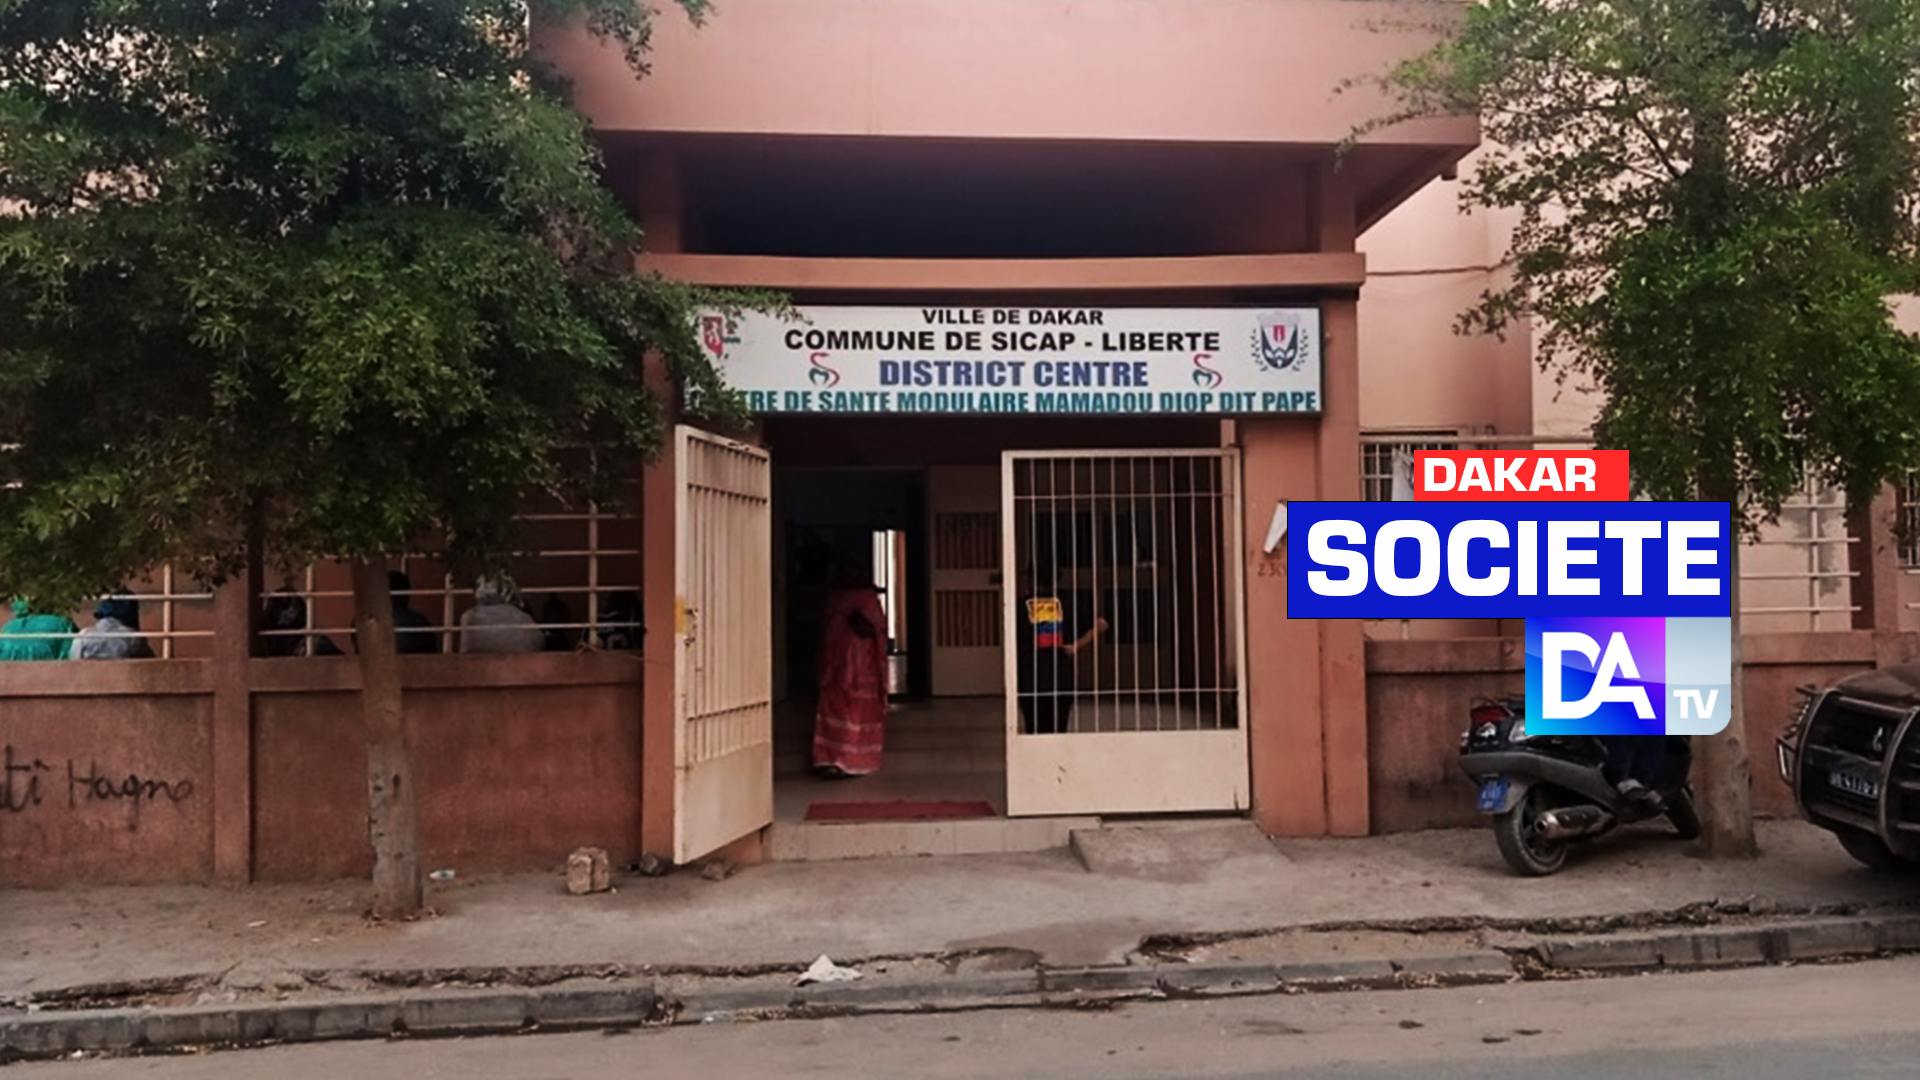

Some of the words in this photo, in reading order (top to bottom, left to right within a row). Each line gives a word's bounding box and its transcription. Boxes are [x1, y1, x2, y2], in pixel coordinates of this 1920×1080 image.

[921, 308, 985, 325] VILLE
[992, 309, 1021, 325] DE
[1028, 309, 1104, 326] DAKAR
[784, 329, 935, 351] COMMUNE
[945, 331, 982, 351] DE
[991, 331, 1076, 352] SICAP
[1102, 331, 1220, 352] LIBERTE
[879, 359, 1026, 387] DISTRICT
[1033, 360, 1149, 388] CENTRE
[784, 390, 811, 412] DE
[818, 390, 890, 413] SANTE
[899, 391, 1029, 413] MODULAIRE
[1034, 391, 1153, 413] MAMADOU
[1159, 392, 1214, 413] DIOP
[1220, 391, 1257, 413] DIT
[1262, 391, 1316, 413] PAPE
